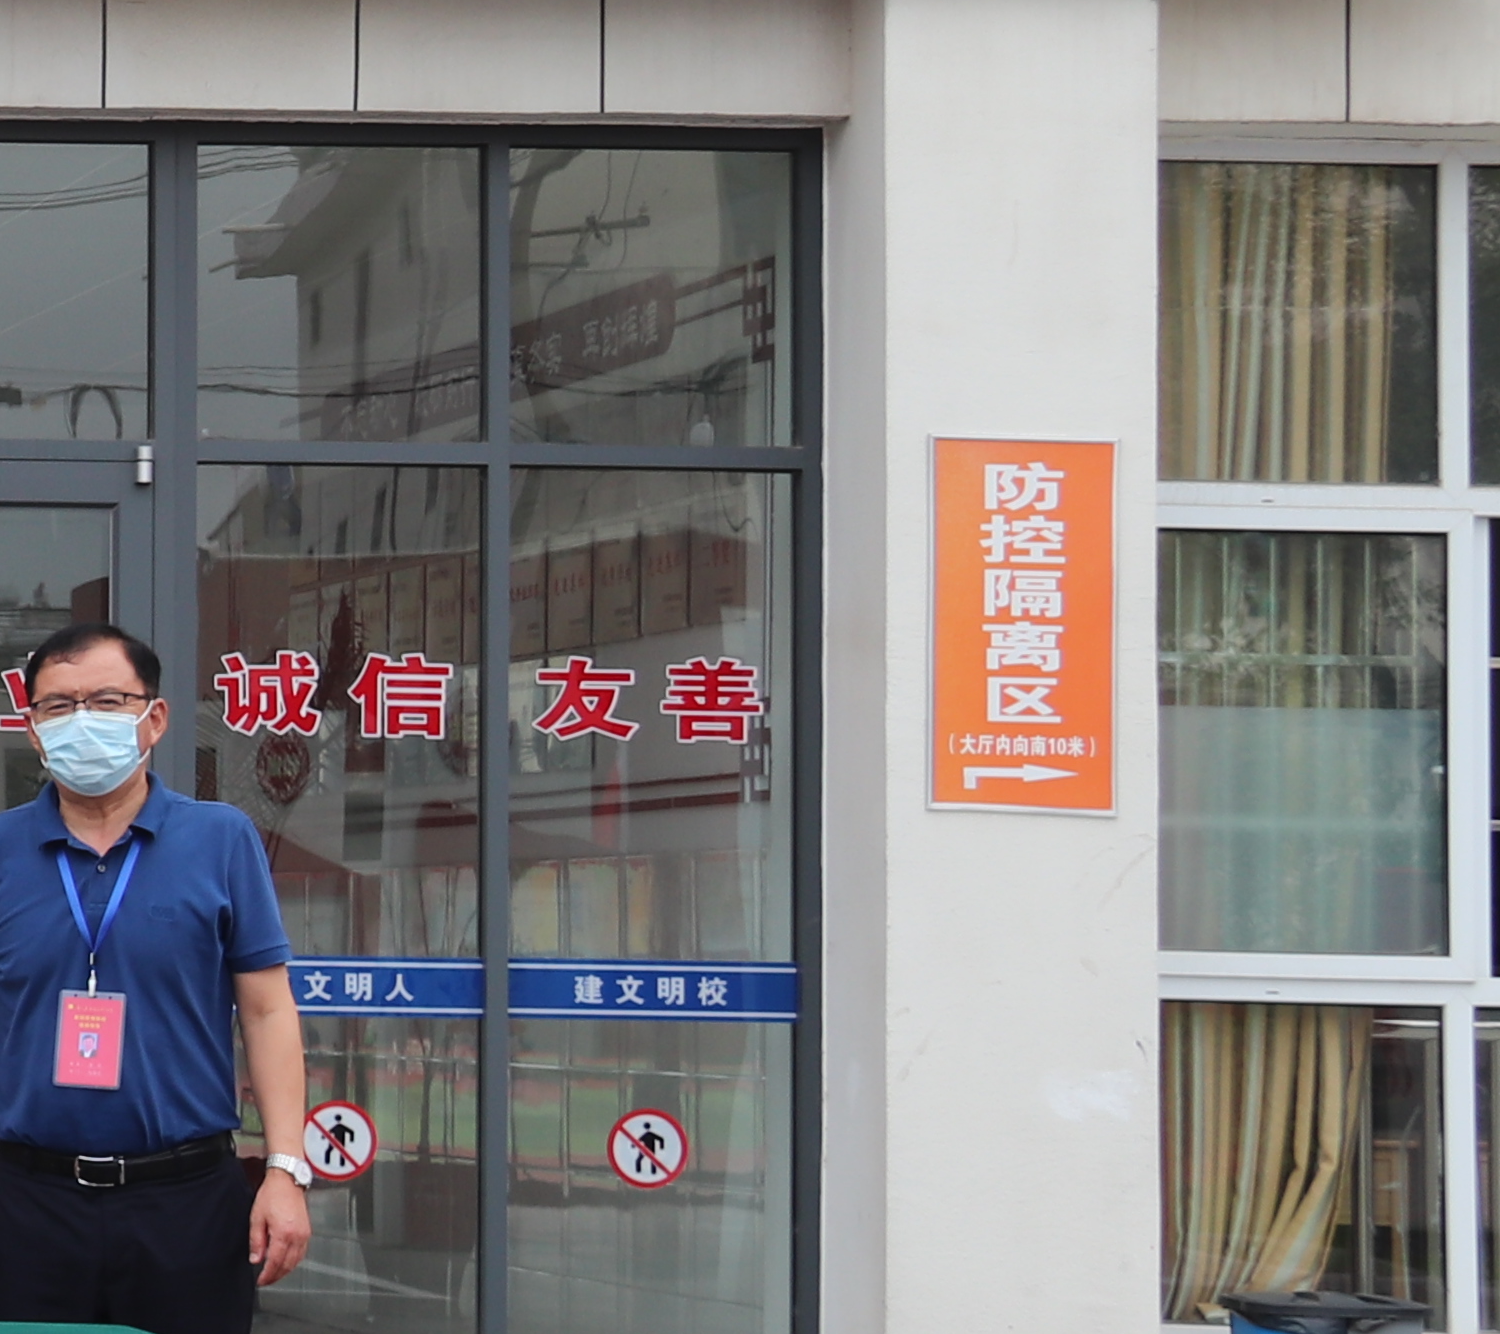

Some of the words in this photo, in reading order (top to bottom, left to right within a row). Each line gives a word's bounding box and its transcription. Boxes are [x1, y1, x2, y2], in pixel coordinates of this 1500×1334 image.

[980, 462, 1066, 723] 防控隔离区
[215, 650, 453, 739] 诚信
[533, 655, 764, 744] 友善
[303, 971, 415, 1003] 文明人
[573, 973, 729, 1008] 建文明校
